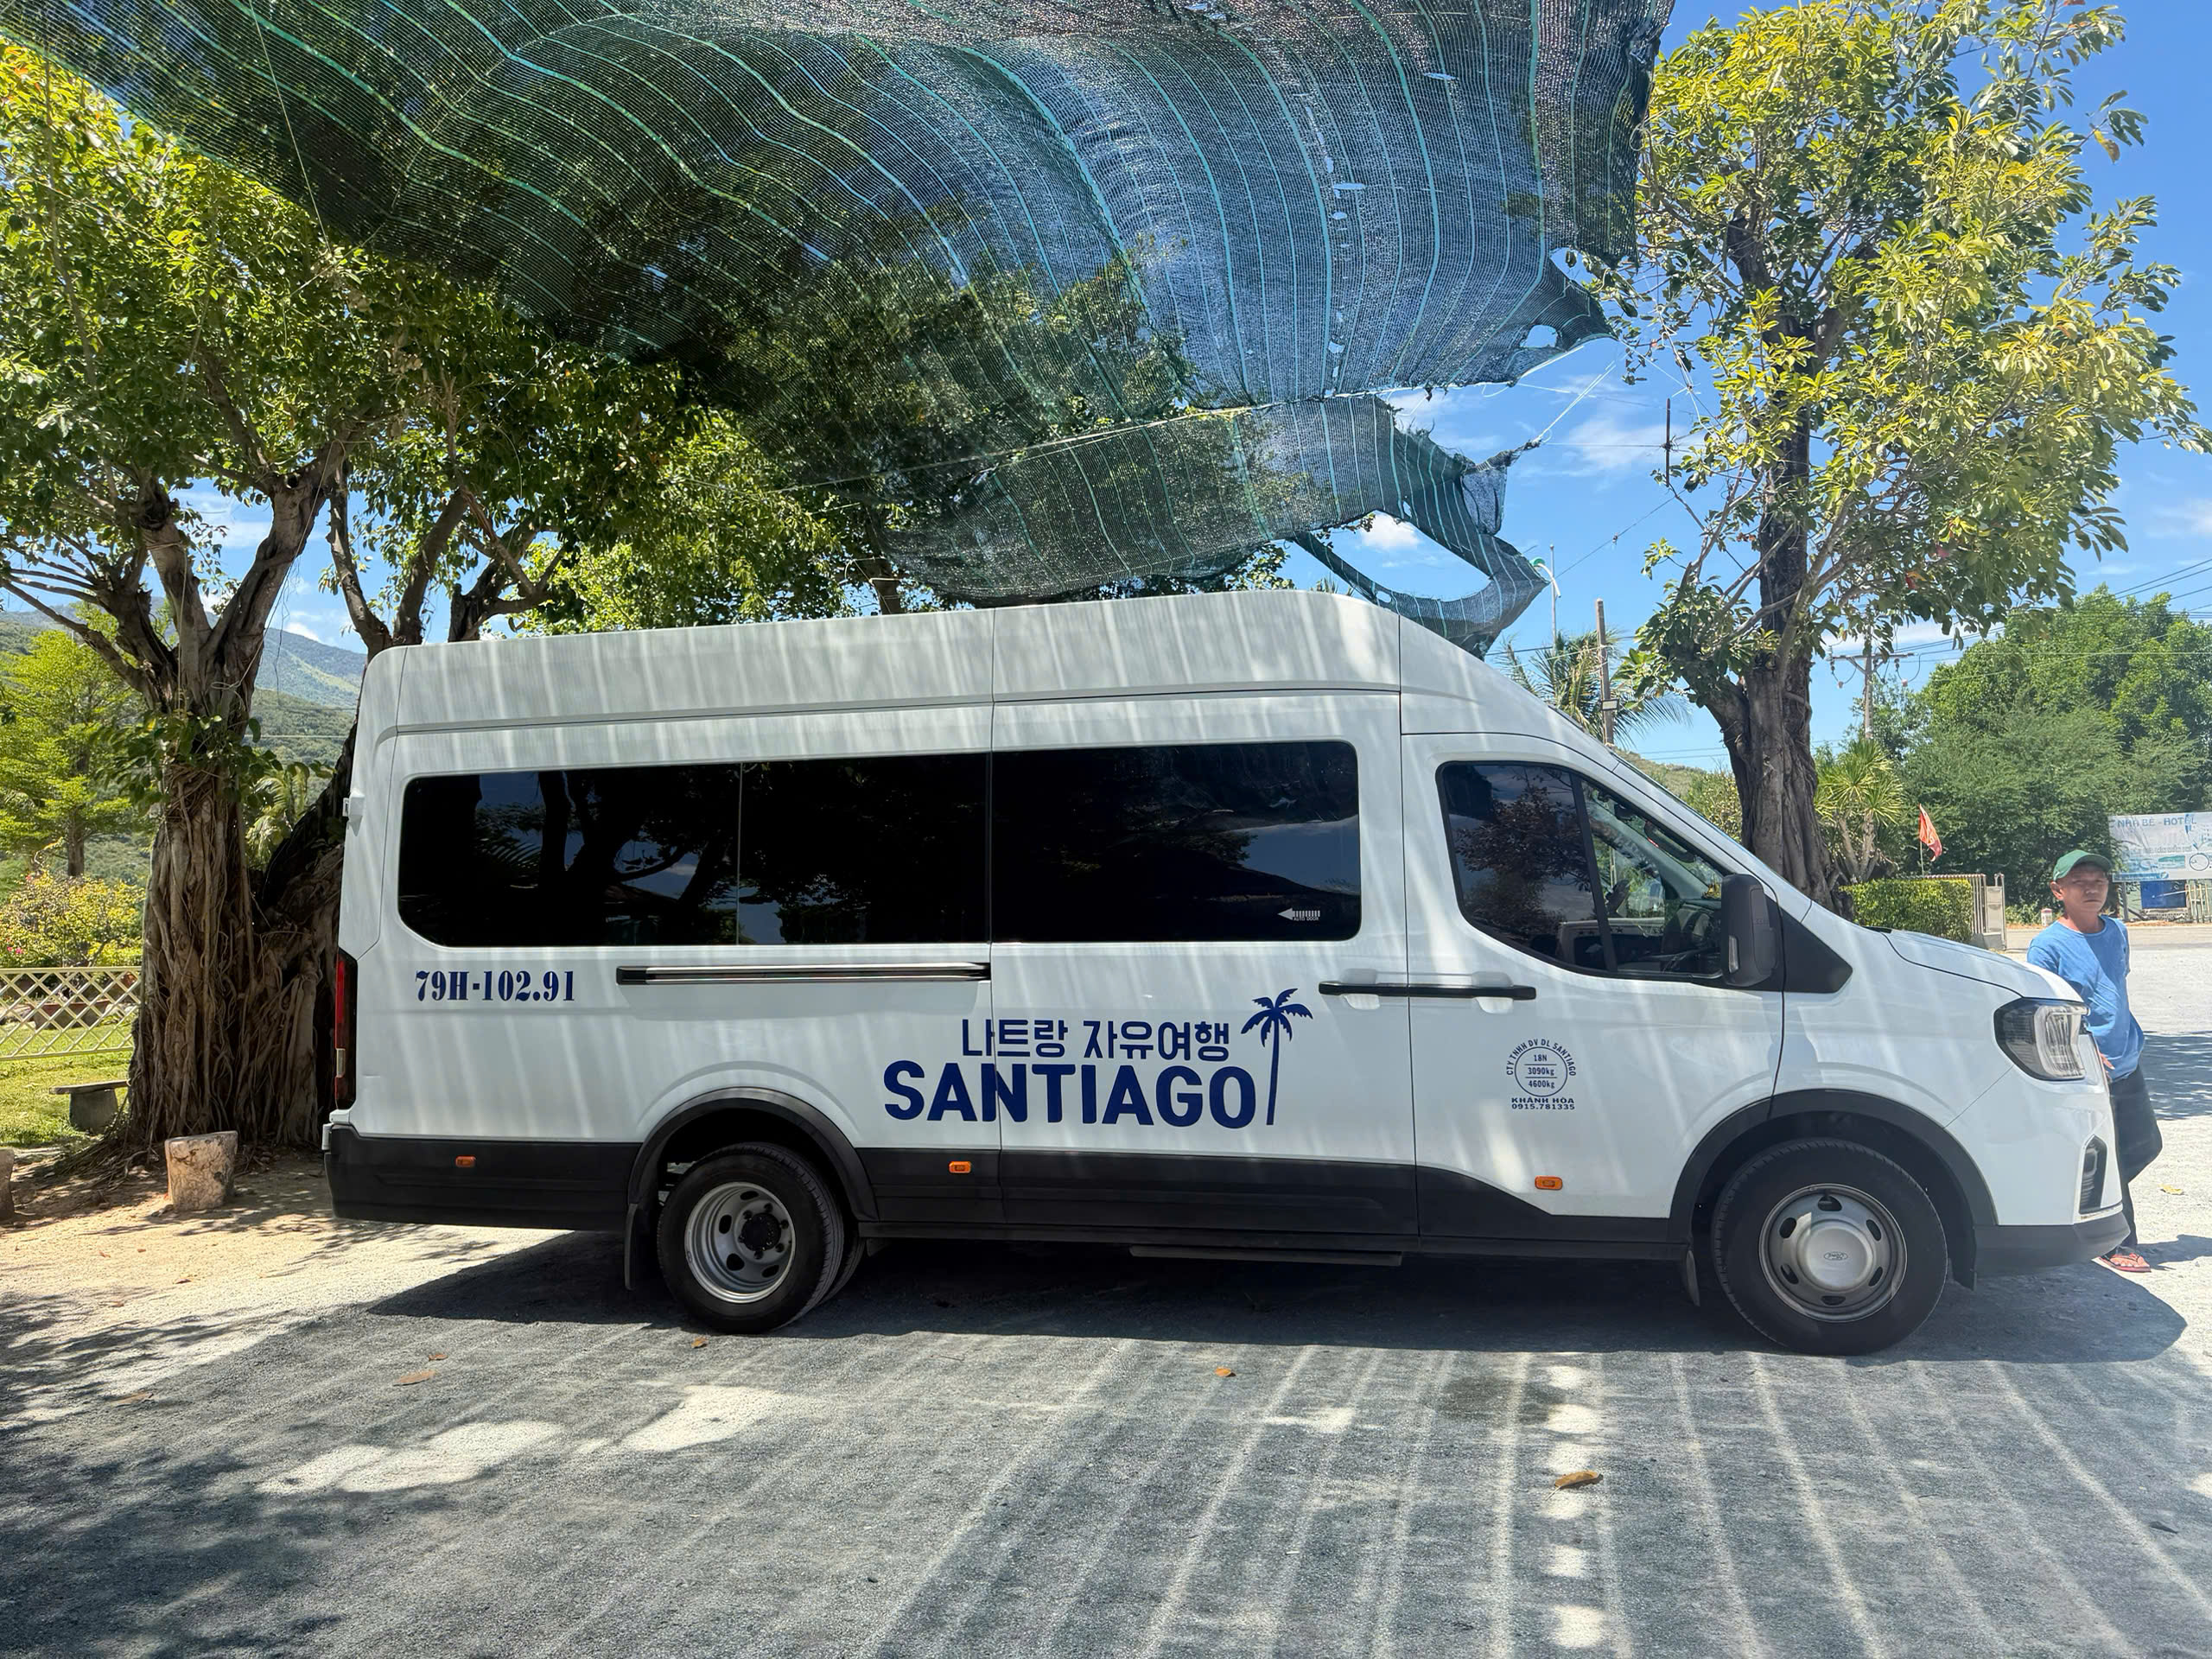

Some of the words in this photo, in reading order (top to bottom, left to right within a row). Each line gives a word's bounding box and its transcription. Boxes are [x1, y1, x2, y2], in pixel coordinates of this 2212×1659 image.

[2164, 816, 2196, 826] HOTEL
[415, 969, 575, 1002] 79H-102.91
[962, 1018, 1069, 1058] 나트랑
[1082, 1020, 1230, 1062] 자유여행
[1528, 1039, 1538, 1047] DV
[1541, 1039, 1550, 1047] DL
[1509, 1042, 1528, 1059] TNHH
[1506, 1060, 1515, 1076] CTY
[1552, 1043, 1576, 1077] SANTIAGO
[1528, 1067, 1554, 1076] 3090kg
[1528, 1080, 1555, 1089] 4600kg
[883, 1059, 1256, 1129] SANTIAGO
